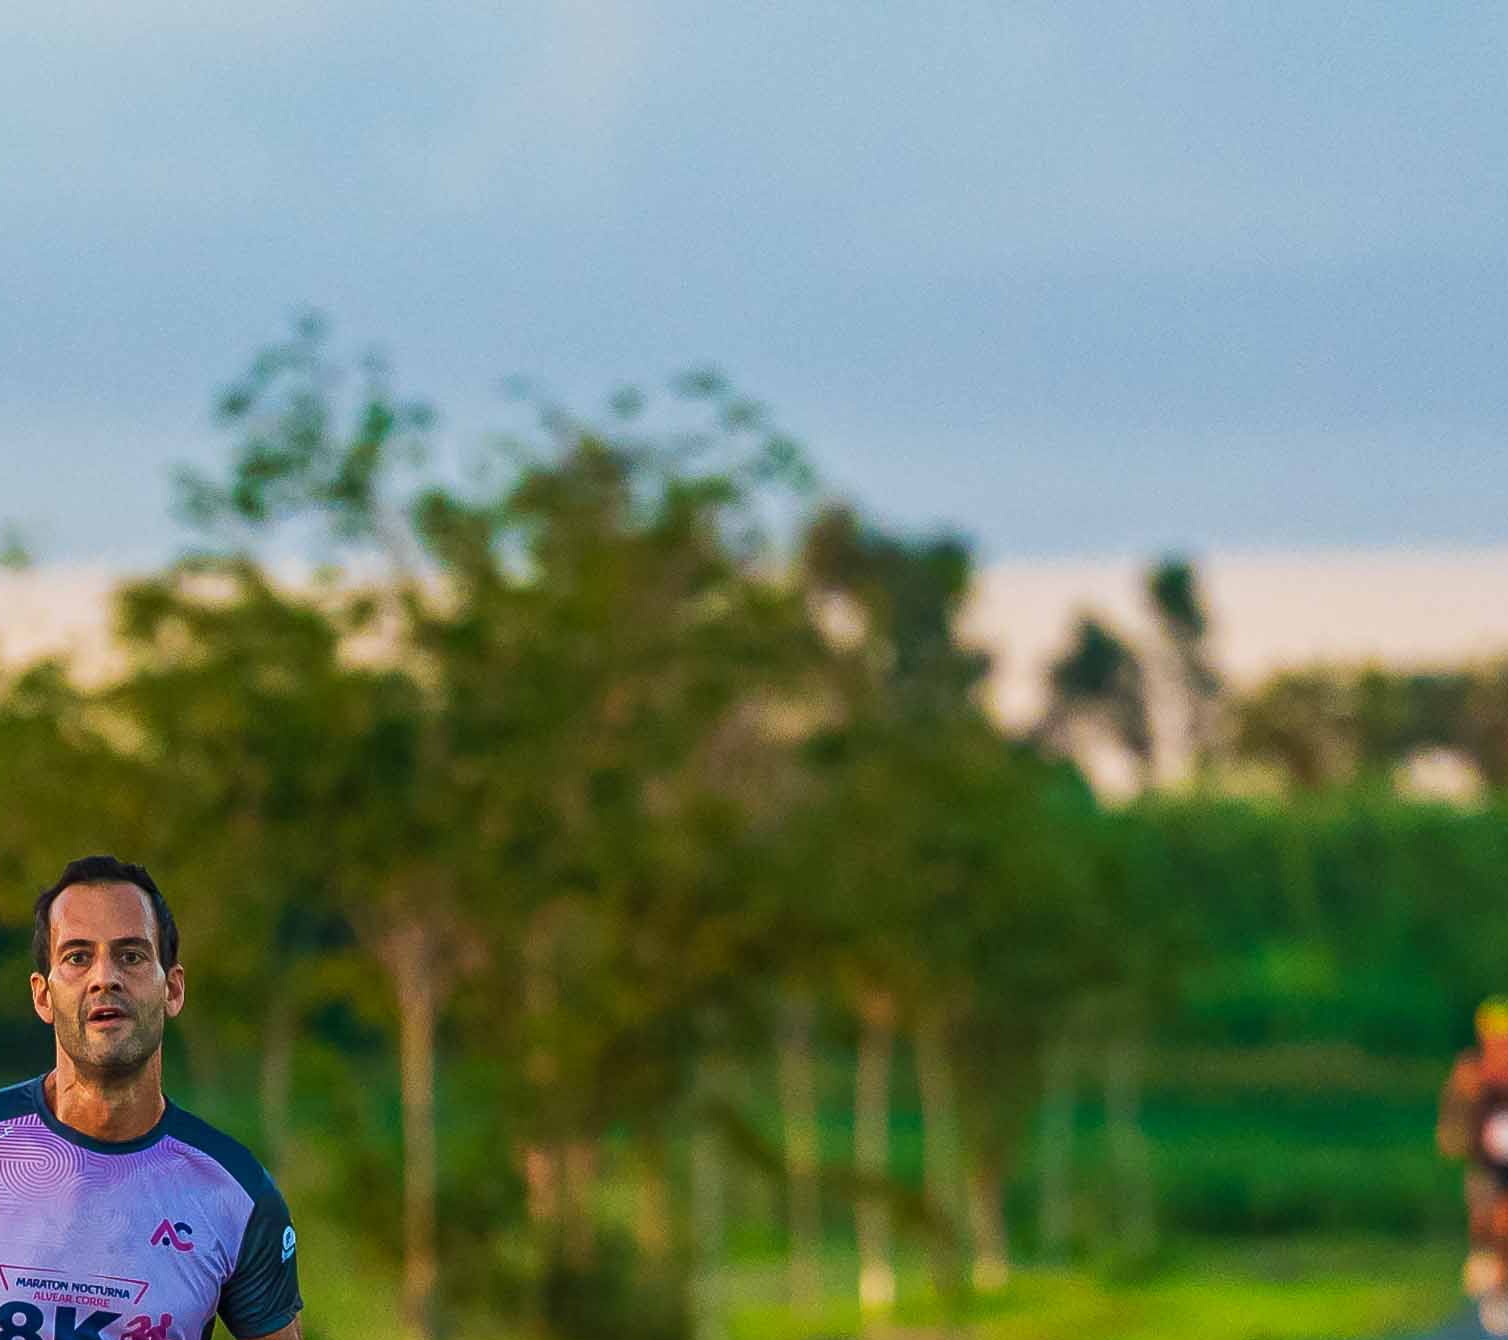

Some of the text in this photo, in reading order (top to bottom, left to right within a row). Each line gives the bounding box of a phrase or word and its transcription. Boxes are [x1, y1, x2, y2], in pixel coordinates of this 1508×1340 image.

[15, 1277, 130, 1299] MARATON NOCTURNA
[33, 1290, 110, 1308] ALVEAR CORRE
